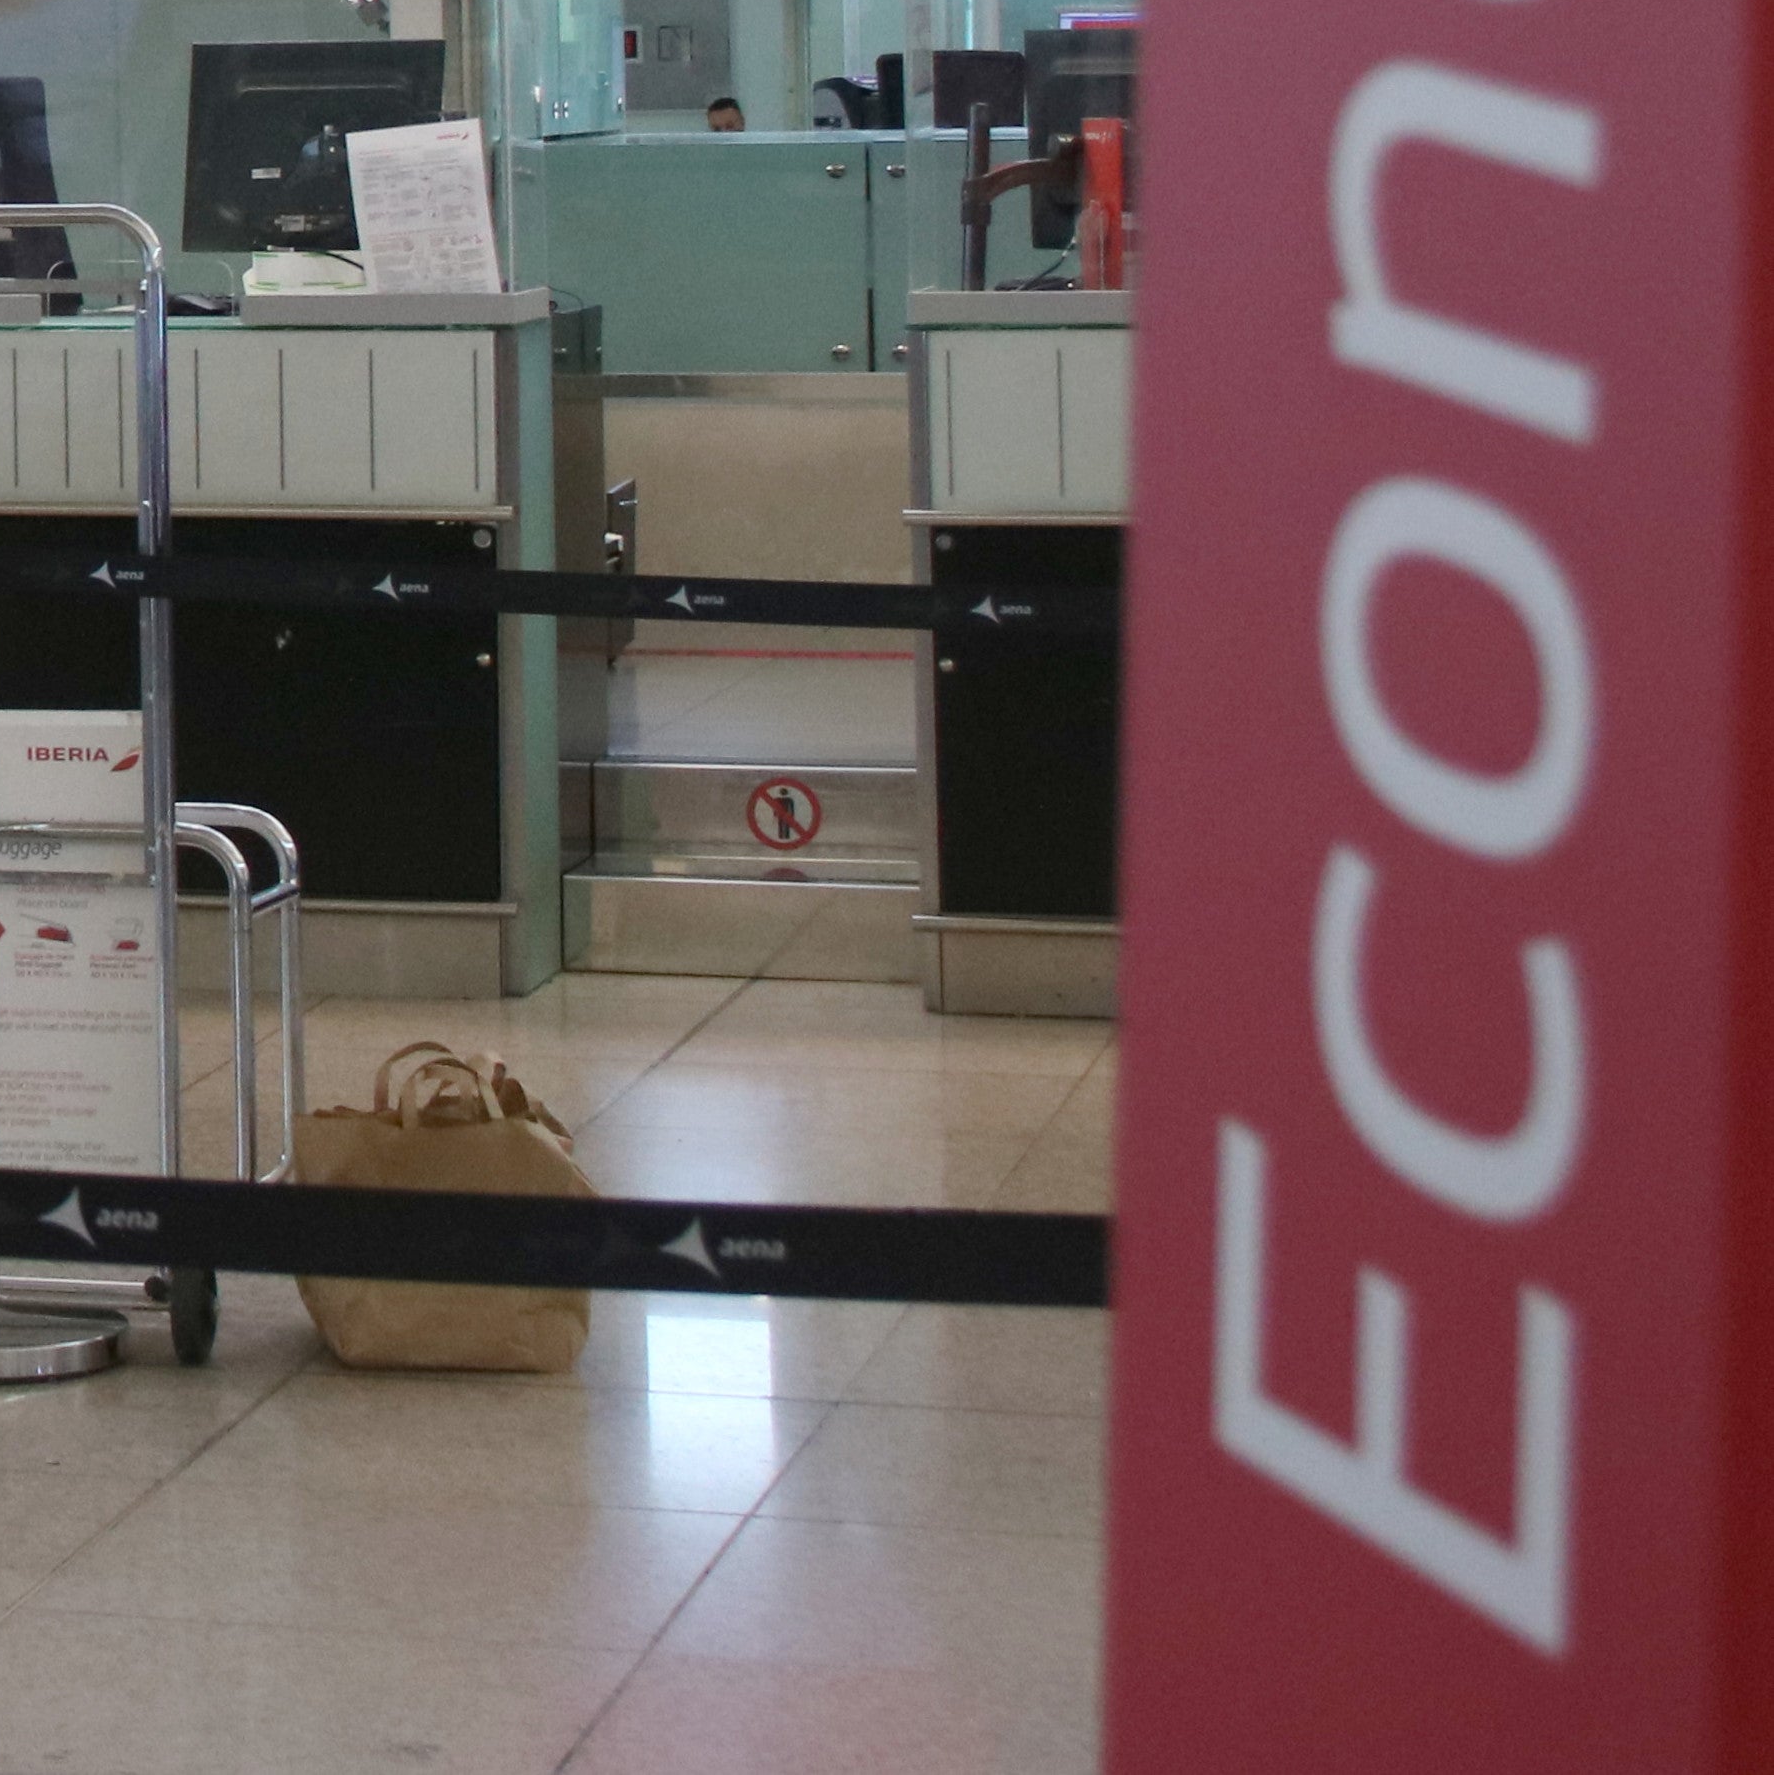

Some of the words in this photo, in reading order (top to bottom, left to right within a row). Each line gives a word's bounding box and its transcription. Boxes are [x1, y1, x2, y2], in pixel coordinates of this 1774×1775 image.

[115, 570, 145, 581] aena
[399, 583, 430, 594] aena
[692, 594, 726, 606] aena
[999, 605, 1033, 615] aena
[27, 746, 109, 762] IBERIA
[95, 1208, 159, 1231] aena
[719, 1238, 786, 1260] aena
